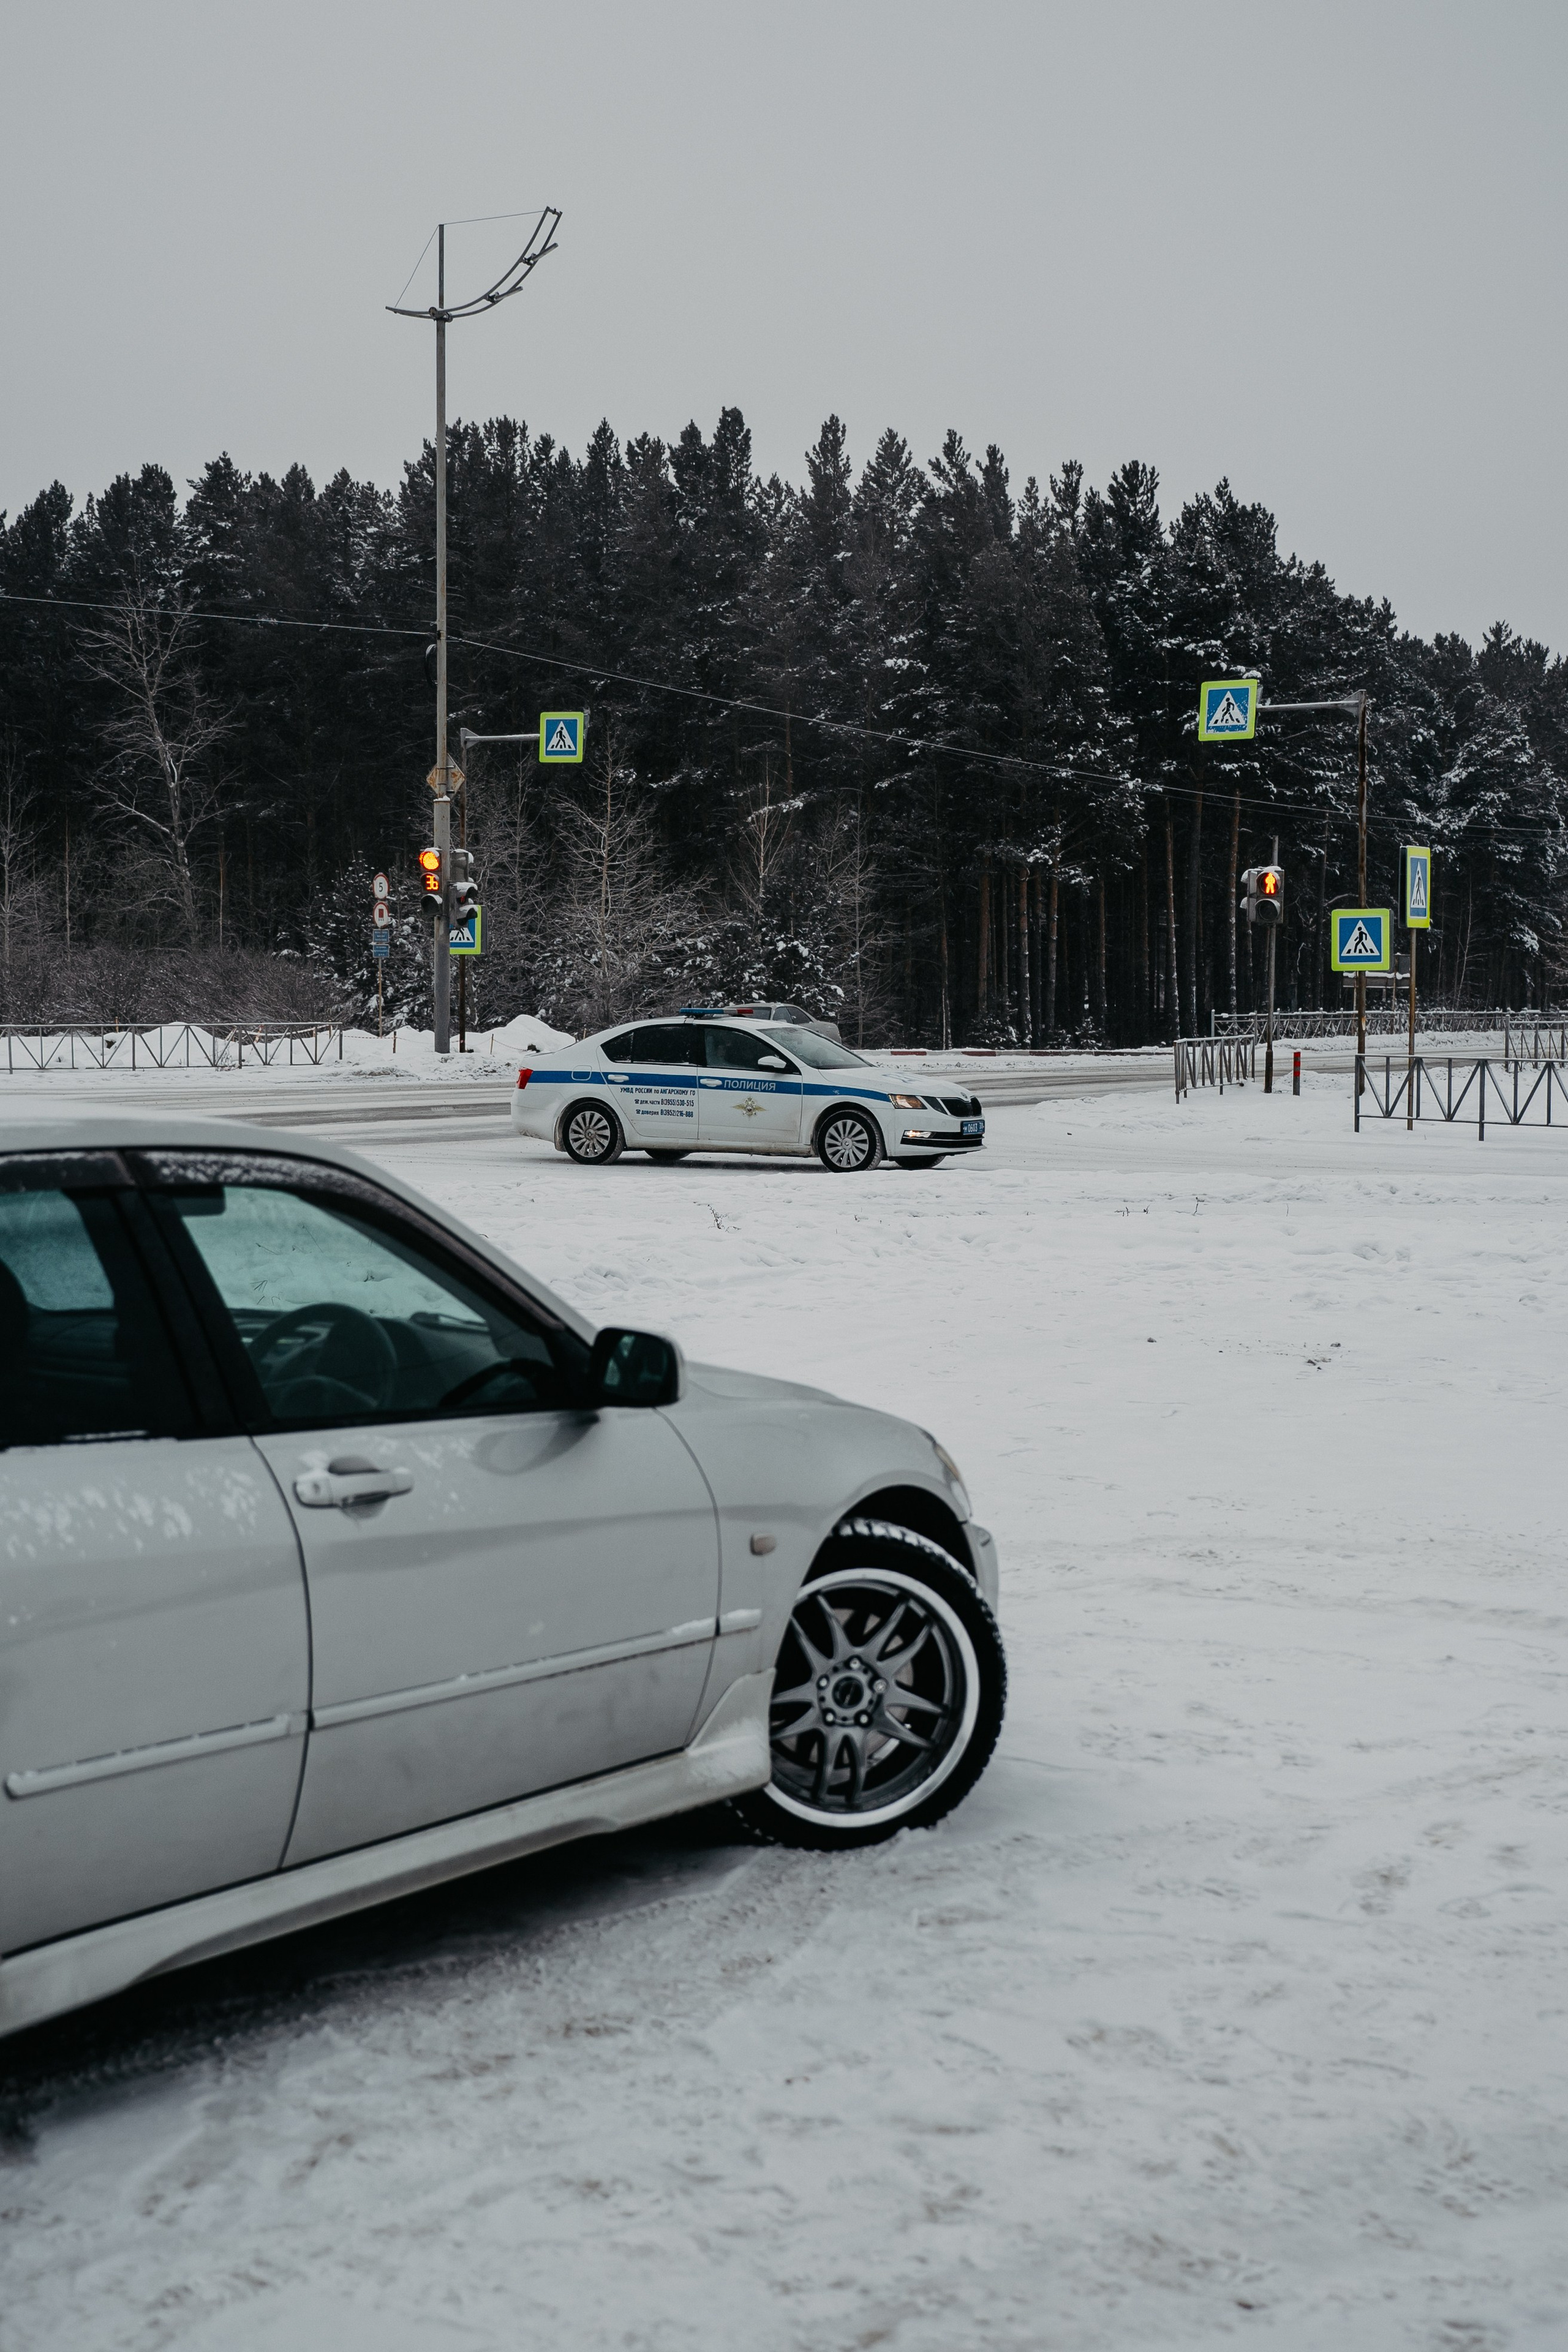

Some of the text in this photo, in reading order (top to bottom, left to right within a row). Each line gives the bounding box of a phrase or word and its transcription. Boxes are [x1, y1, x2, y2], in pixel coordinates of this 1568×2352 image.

[379, 882, 383, 892] 5
[426, 875, 439, 890] 36
[724, 1080, 776, 1091] ПОЛИЦИЯ
